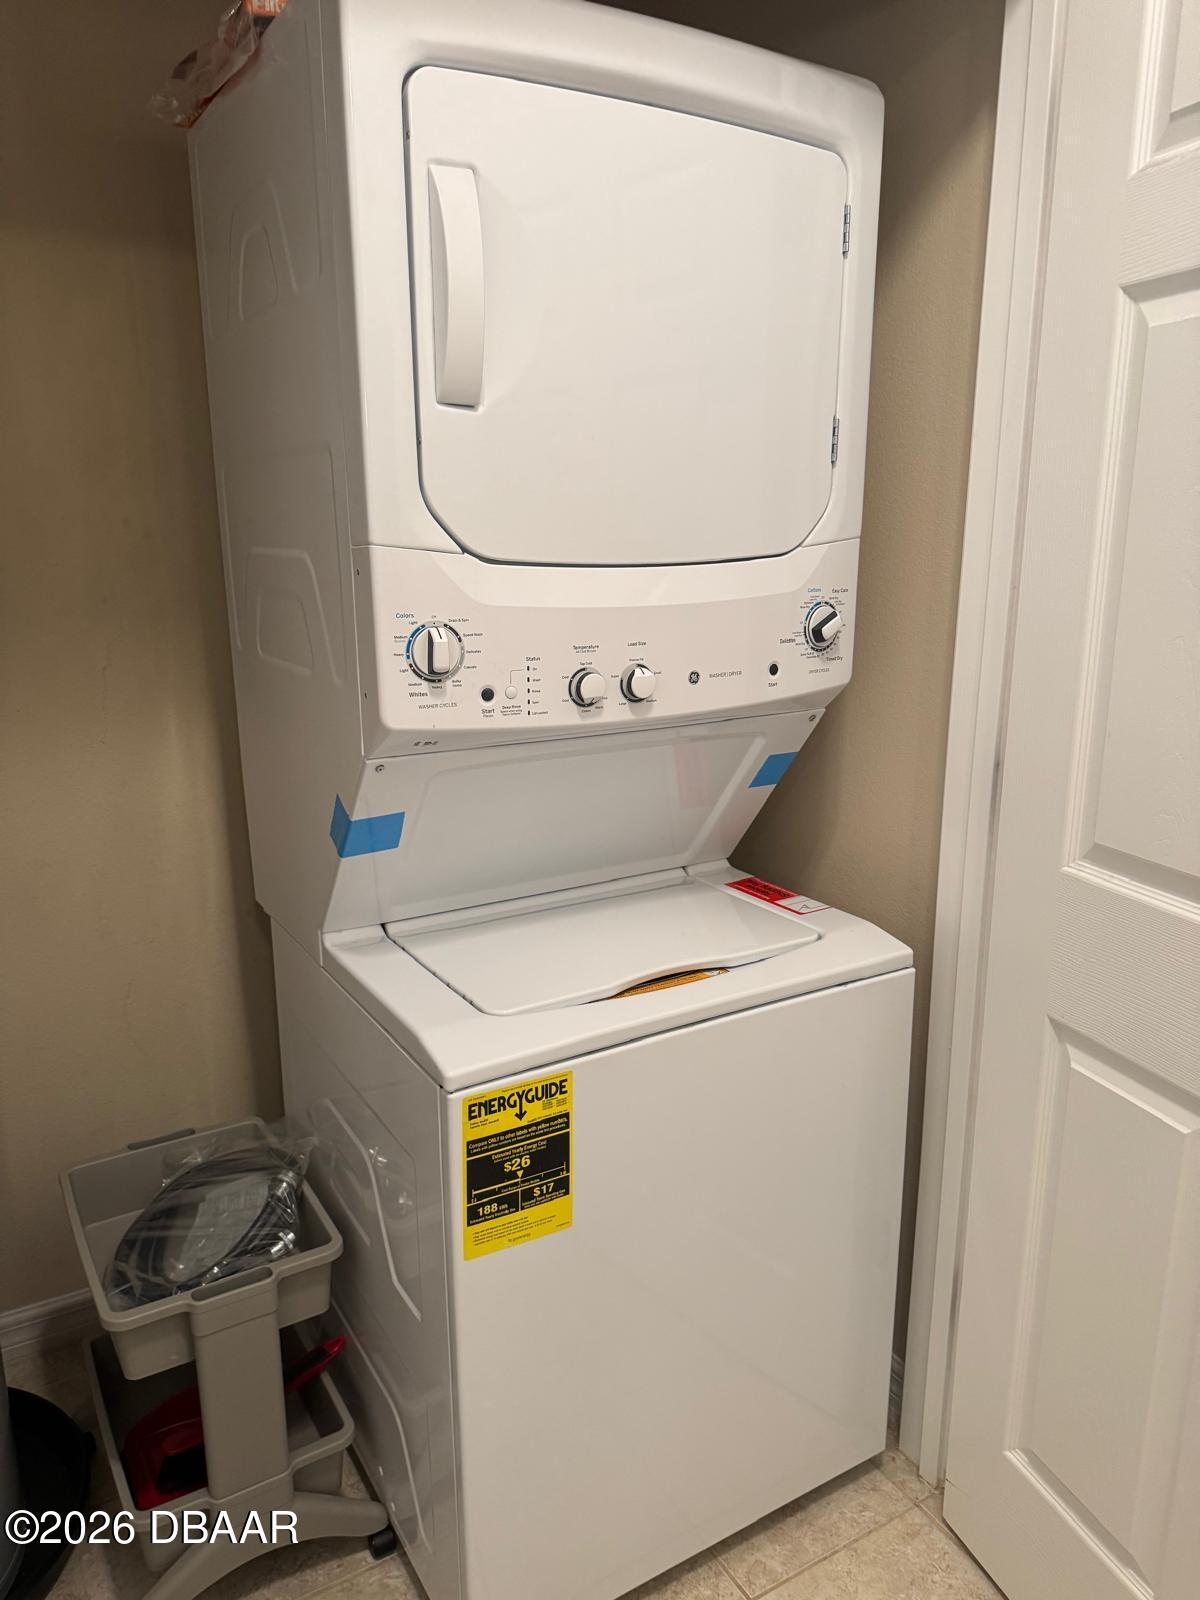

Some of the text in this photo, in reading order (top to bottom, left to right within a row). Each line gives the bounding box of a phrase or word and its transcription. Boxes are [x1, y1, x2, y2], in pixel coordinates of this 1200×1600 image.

[468, 1078, 568, 1122] ENERGYGUIDE
[504, 1155, 531, 1172] $26
[534, 1183, 554, 1197] $17
[477, 1203, 498, 1216] 188
